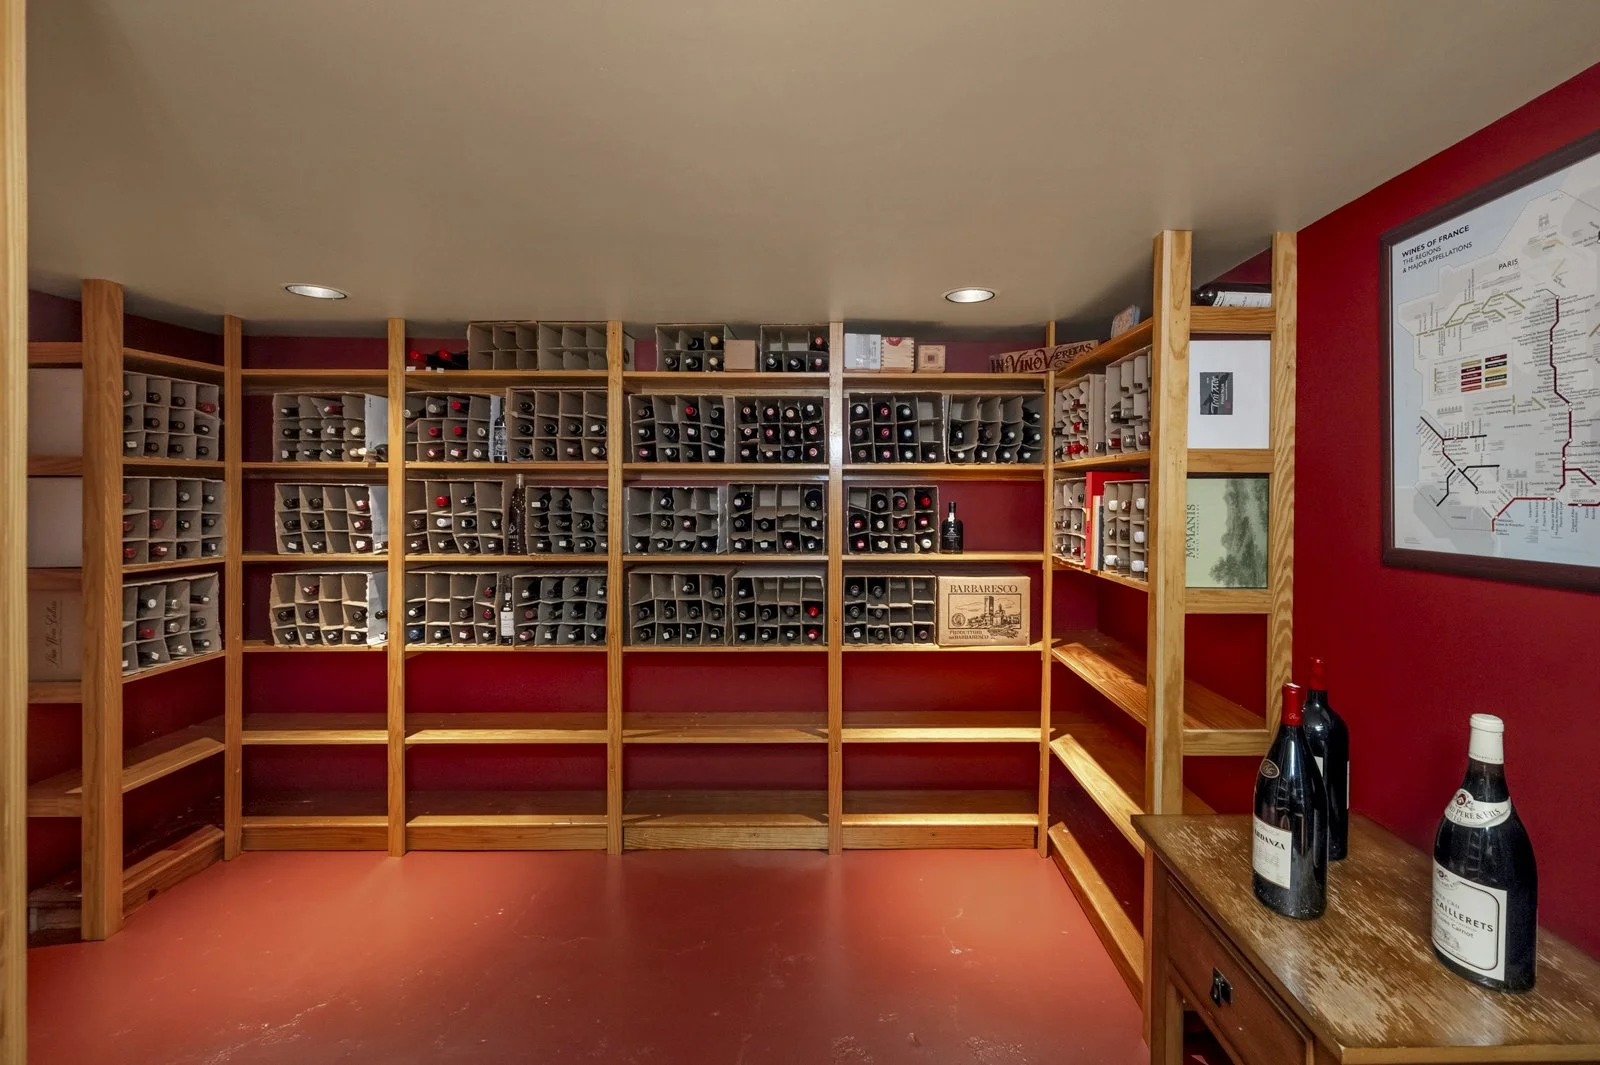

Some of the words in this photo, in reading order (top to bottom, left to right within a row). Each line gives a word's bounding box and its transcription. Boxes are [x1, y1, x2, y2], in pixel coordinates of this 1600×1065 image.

[1401, 243, 1425, 258] WINES
[1426, 238, 1437, 248] OF
[1438, 224, 1470, 243] FRANCE
[1403, 257, 1414, 265] THE
[1415, 246, 1442, 260] REGIONS
[1407, 259, 1428, 272] MAJOR
[1428, 241, 1473, 264] APPELLATIONS
[1498, 258, 1519, 270] PARIS
[990, 359, 1004, 373] IN
[1005, 351, 1043, 373] VINO
[1034, 343, 1094, 369] VERITAS
[950, 584, 1018, 593] BARBARESCO
[1435, 897, 1494, 933] CAILLERETS
